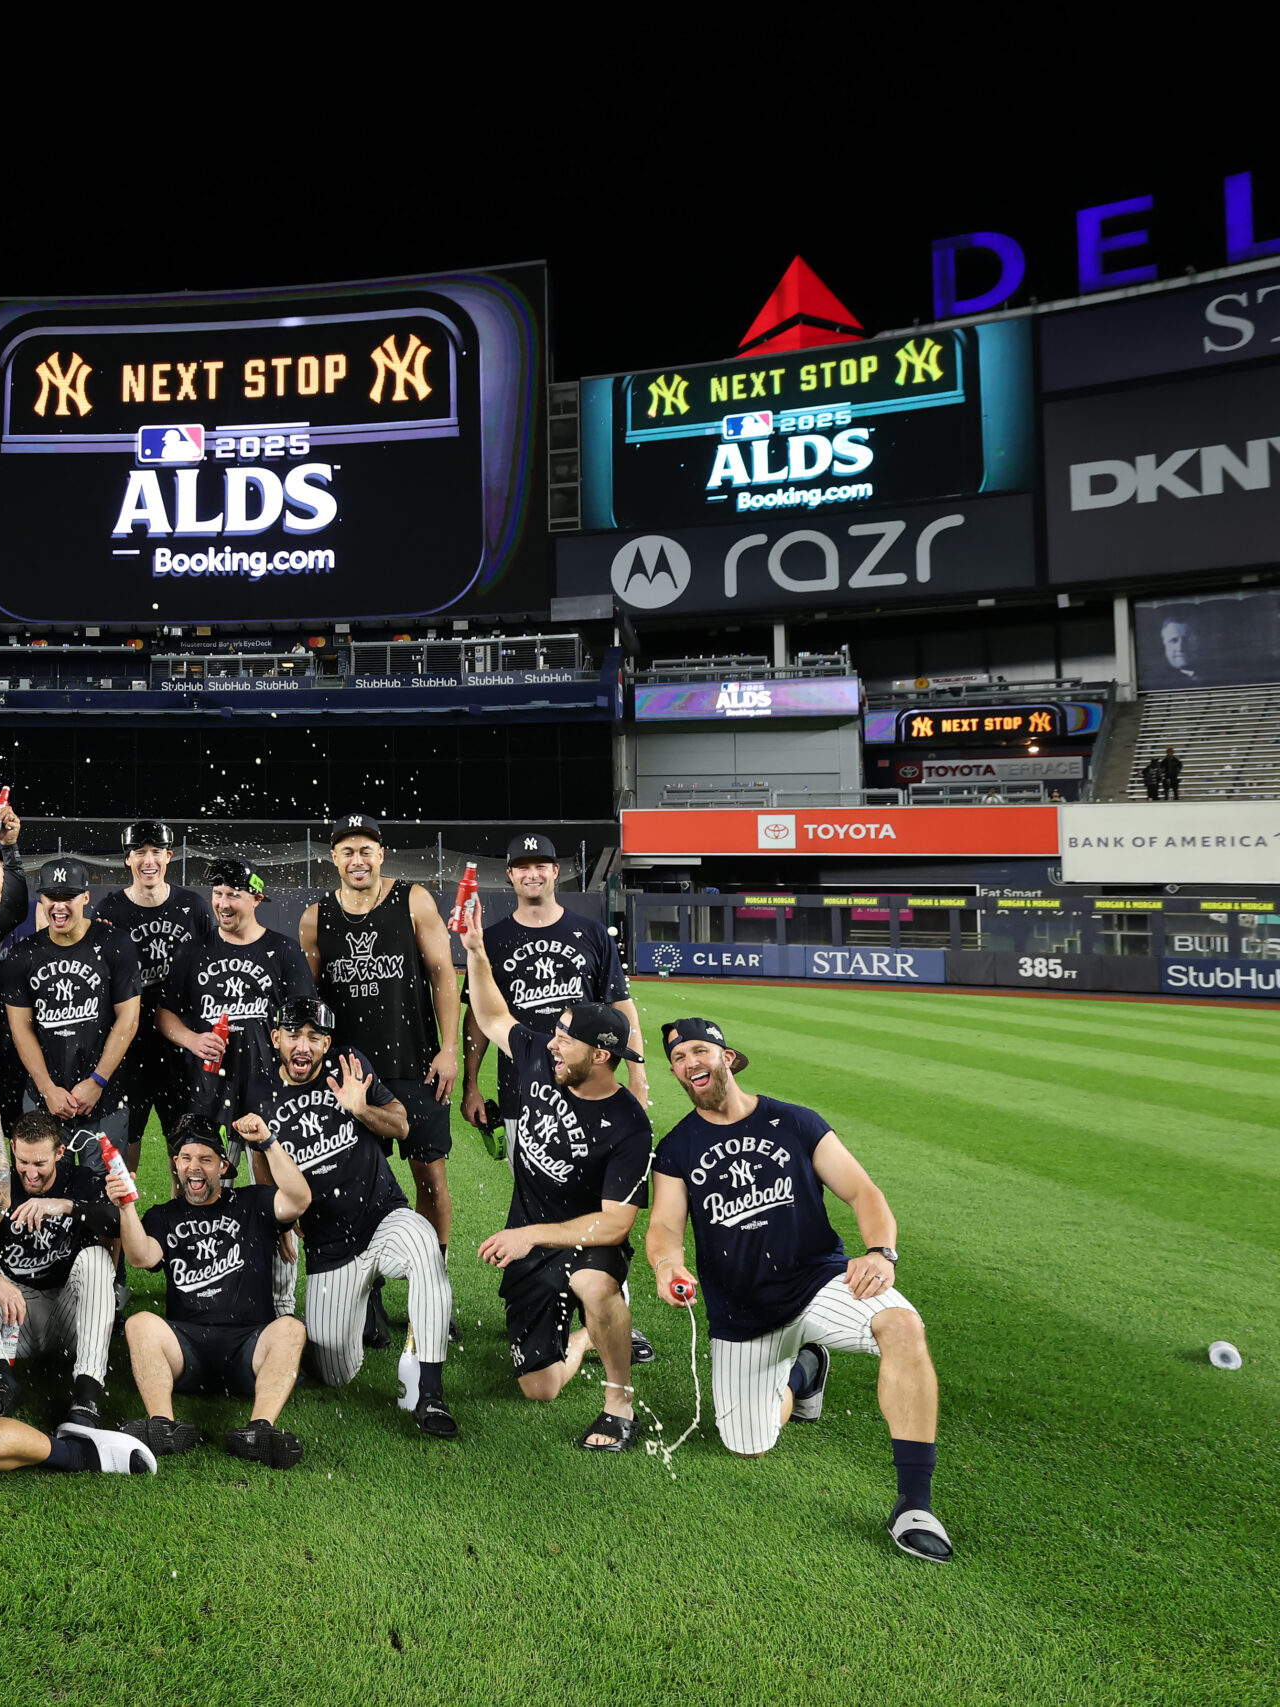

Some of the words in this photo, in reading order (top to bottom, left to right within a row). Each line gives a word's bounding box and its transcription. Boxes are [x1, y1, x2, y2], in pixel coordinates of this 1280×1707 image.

[121, 361, 224, 403] NEXT
[244, 353, 346, 398] STOP
[710, 367, 786, 403] NEXT
[799, 355, 878, 392] STOP
[780, 410, 852, 432] 2025
[215, 434, 310, 459] 2025
[707, 427, 874, 489] ALDS
[113, 463, 338, 533] ALDS
[737, 480, 873, 511] Booking.com
[155, 547, 335, 576] Booking.com
[724, 514, 965, 598] razr
[161, 681, 203, 692] StubHub
[208, 681, 250, 691] StubHub
[255, 679, 298, 690] StubHub
[355, 678, 401, 688] StubHub
[411, 677, 457, 688] StubHub
[468, 675, 514, 686] StubHub
[525, 673, 572, 685] StubHub
[715, 690, 772, 709] ALDS
[941, 718, 979, 732] NEXT
[984, 716, 1022, 731] STOP
[924, 764, 996, 778] TOYOTA
[997, 761, 1082, 776] TERRACE
[804, 824, 896, 840] TOYOTA
[1068, 836, 1125, 848] BANK
[1131, 836, 1160, 848] OF
[1166, 835, 1267, 848] AMERICA
[502, 939, 587, 973] OCTOBER
[693, 953, 759, 967] CLEAR
[813, 951, 919, 978] STARR
[1019, 957, 1062, 978] 385
[1064, 970, 1077, 979] FT
[29, 959, 101, 991] OCTOBER
[197, 958, 272, 991] OCTOBER
[510, 975, 584, 1003] Baseball
[35, 998, 99, 1023] Baseball
[200, 994, 268, 1021] Baseball
[530, 1080, 589, 1159] OCTOBER
[281, 1121, 358, 1164] Baseball
[690, 1136, 791, 1186] OCTOBER
[703, 1176, 794, 1225] Baseball
[170, 1243, 245, 1285] Baseball
